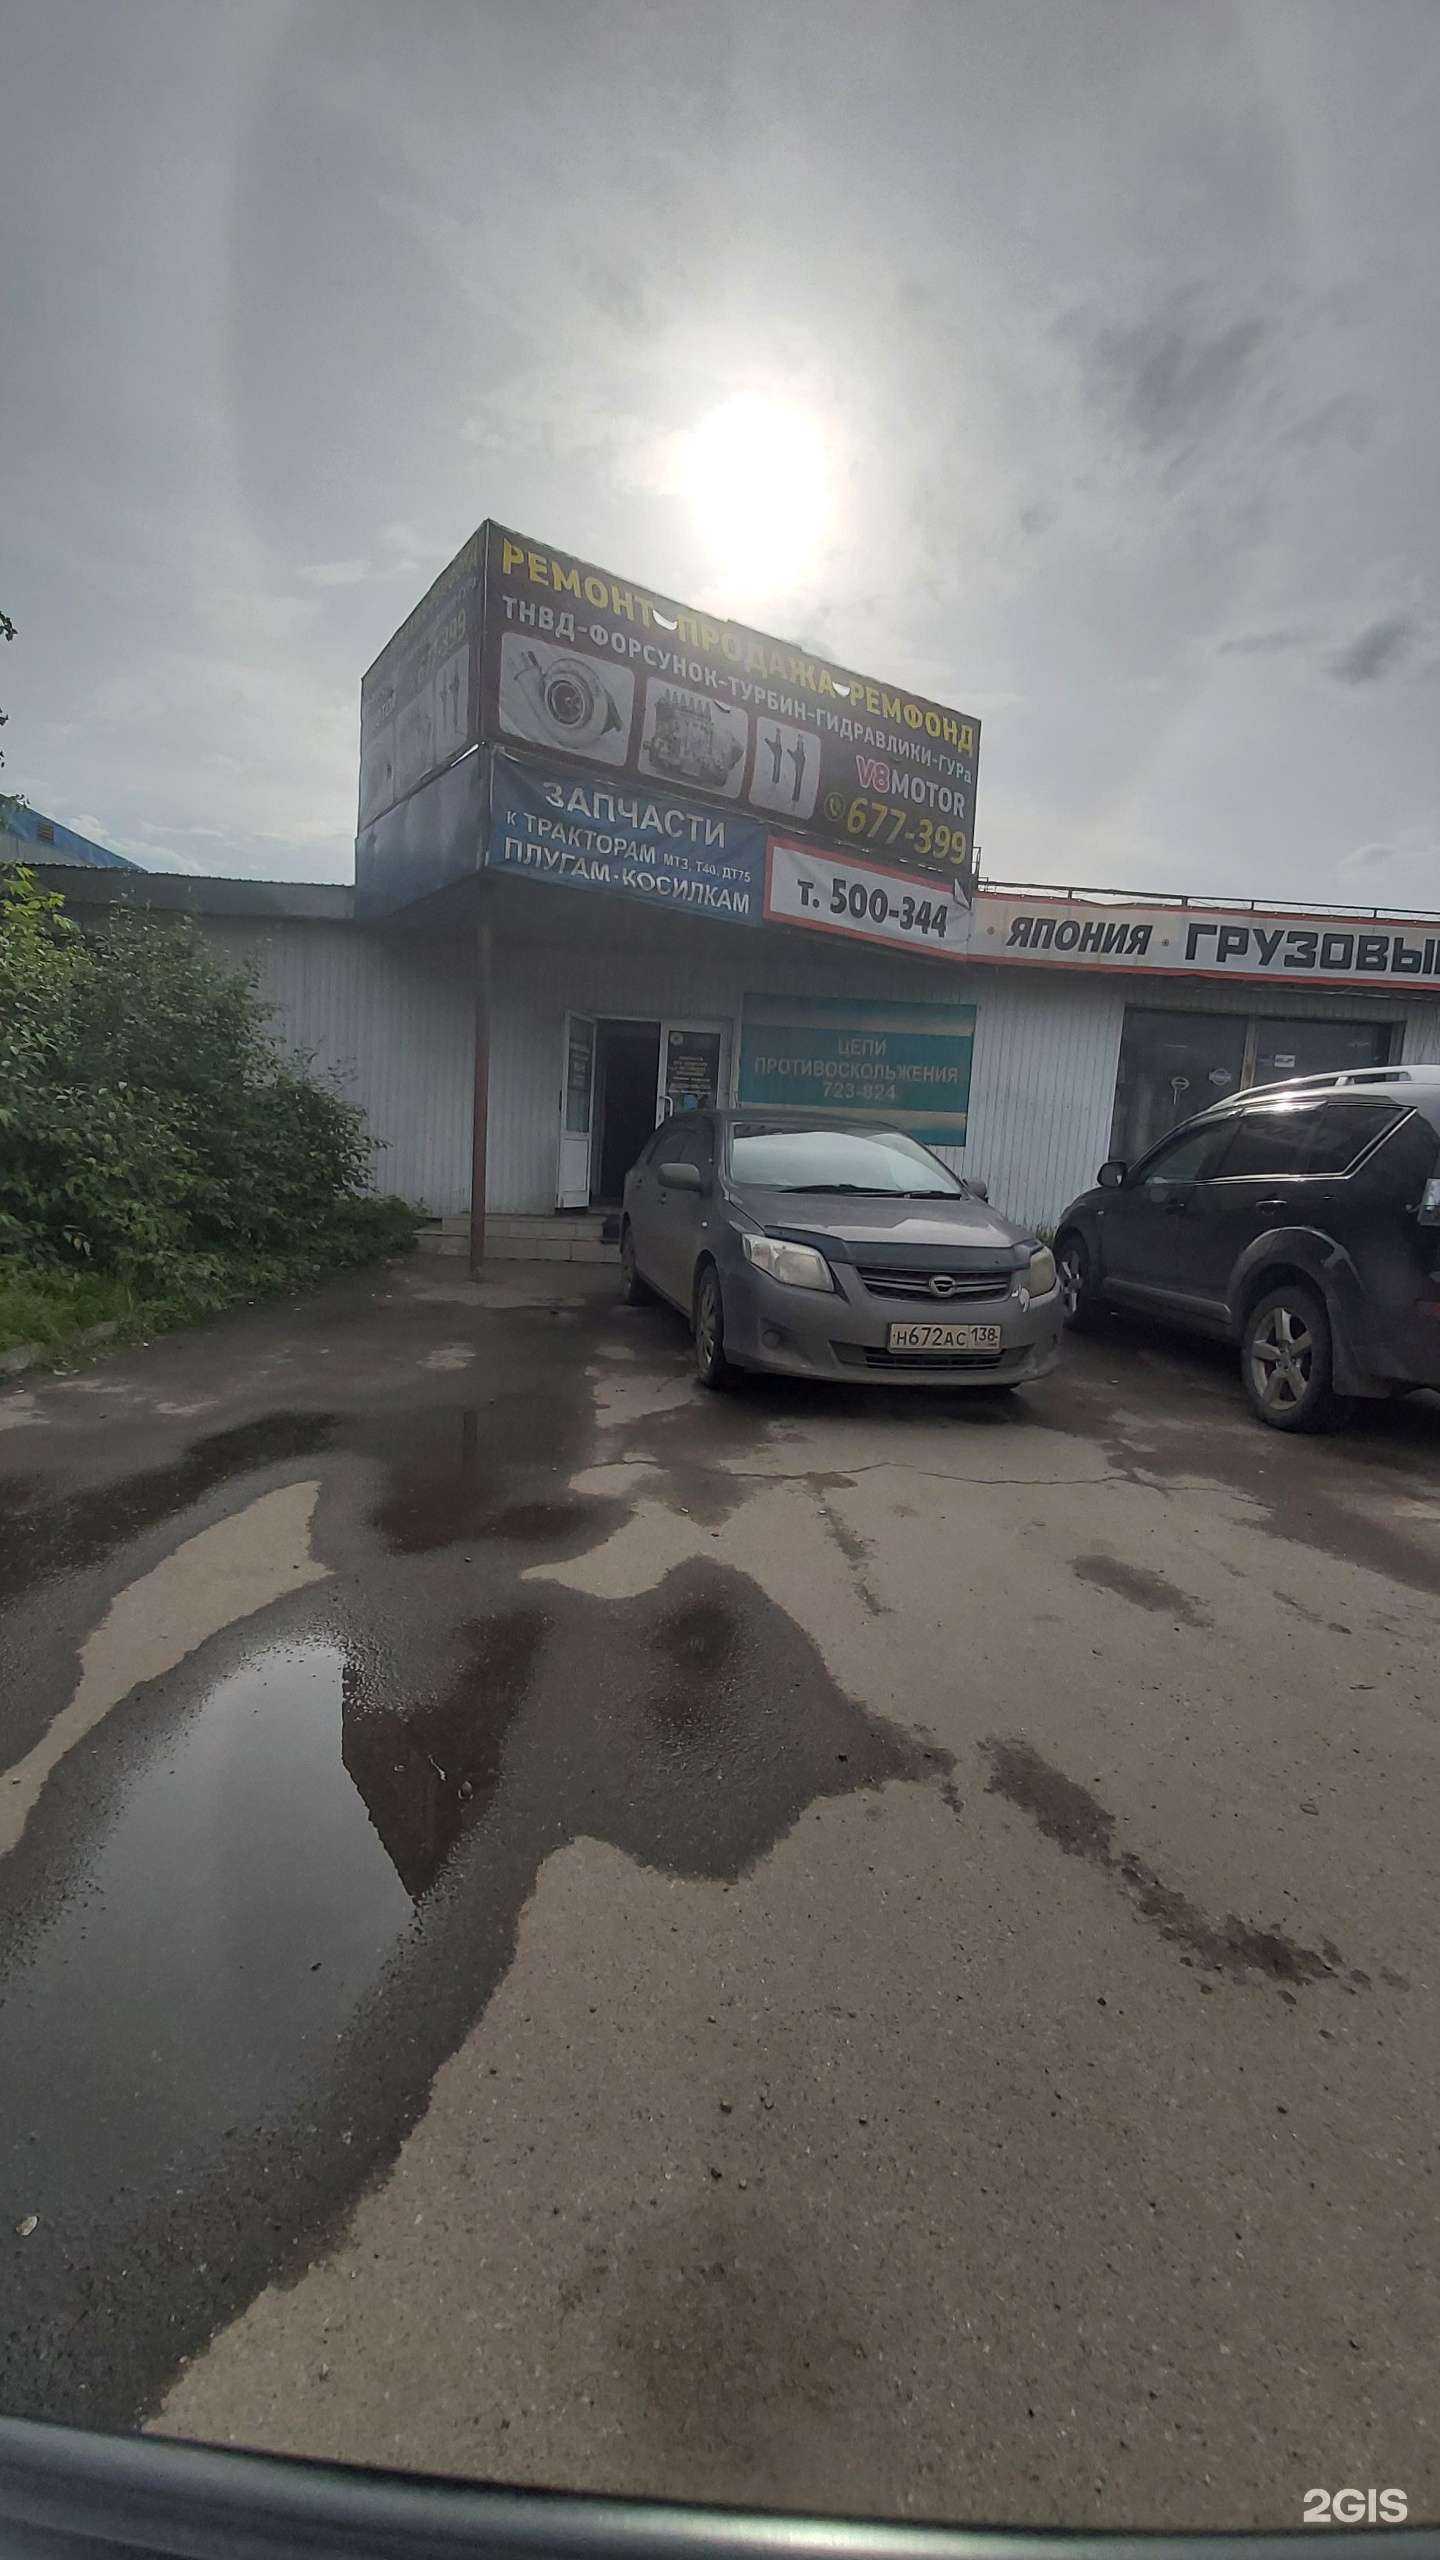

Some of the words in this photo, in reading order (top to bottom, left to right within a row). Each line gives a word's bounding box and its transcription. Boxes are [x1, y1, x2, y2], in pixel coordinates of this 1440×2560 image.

[523, 812, 656, 865] ТРАКТОРАМ
[543, 782, 727, 849] ЗАПЧАСТИ
[847, 797, 967, 865] 677-399
[829, 877, 949, 938] 500-344
[1005, 916, 1153, 955] ЯПОНИЯ
[1184, 922, 1440, 976] ГРУЗОВЫ
[754, 1057, 960, 1084] ПРОТИВОСКОЛЬЖЕНИЯ
[838, 1037, 887, 1057] ЦЕПИ
[823, 1081, 897, 1100] 723-824
[971, 1327, 996, 1342] 138
